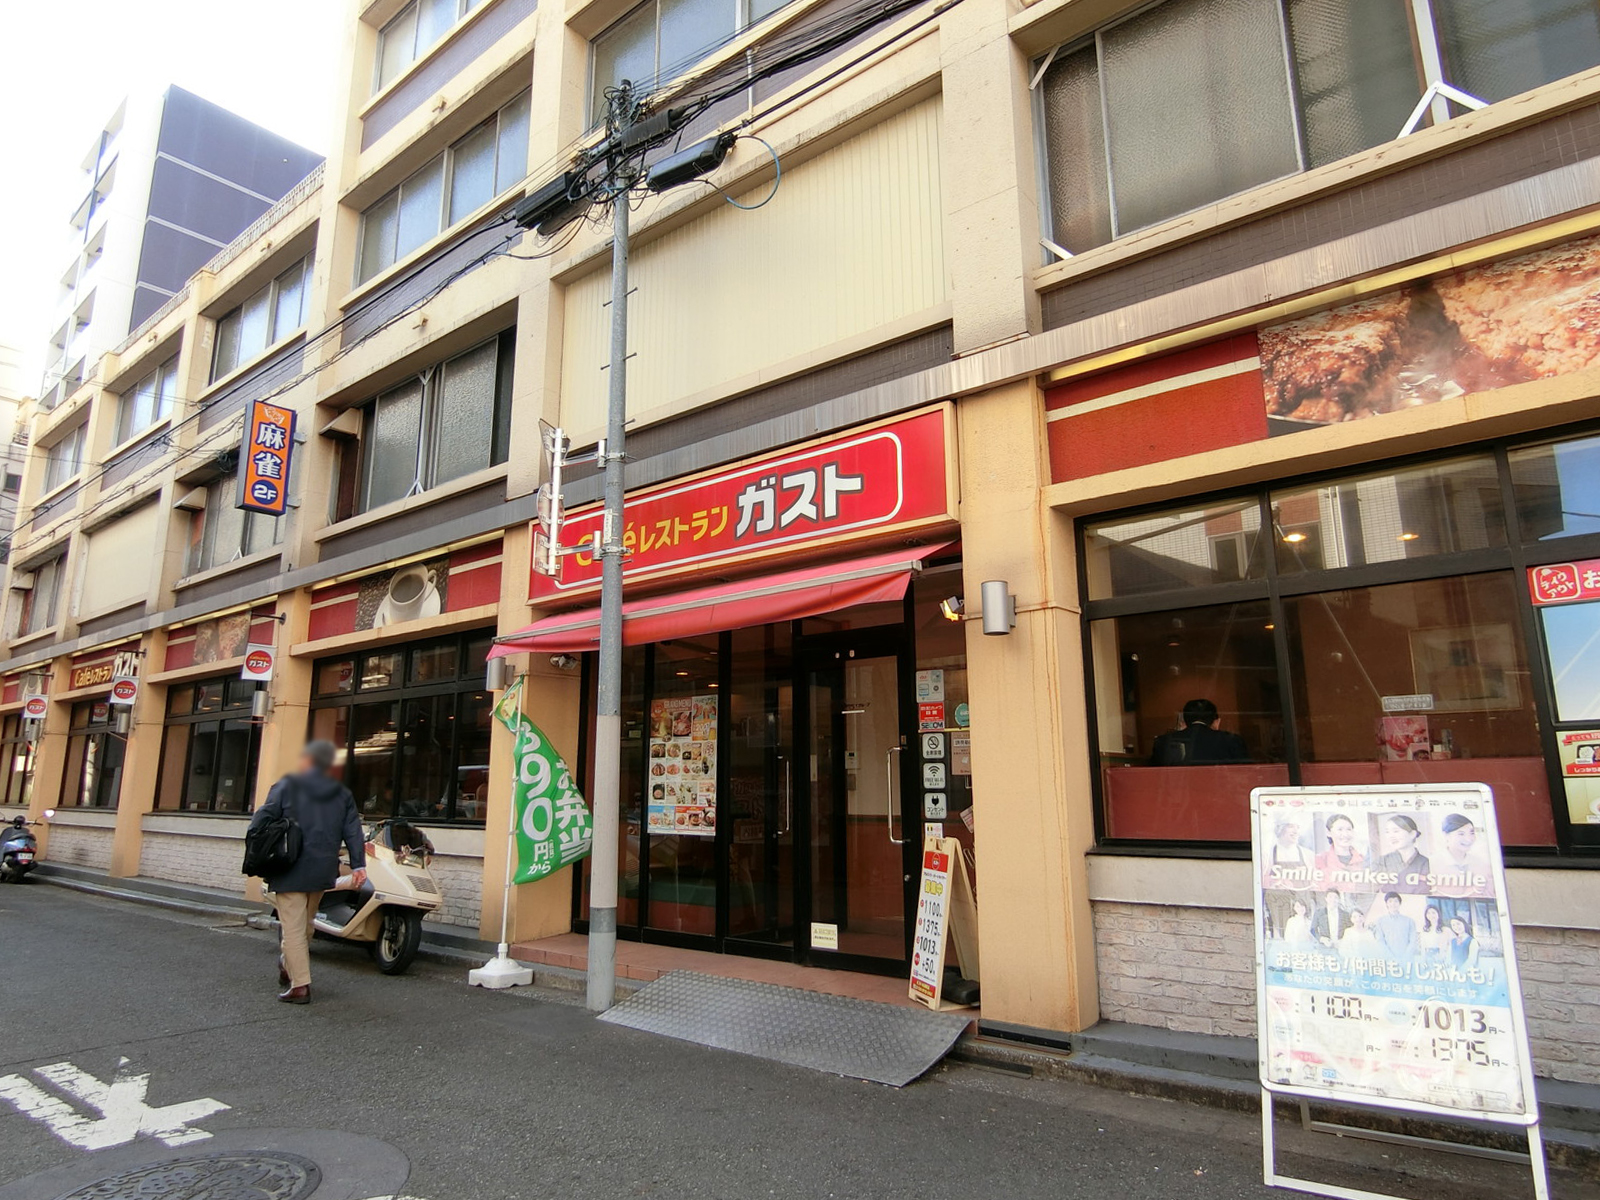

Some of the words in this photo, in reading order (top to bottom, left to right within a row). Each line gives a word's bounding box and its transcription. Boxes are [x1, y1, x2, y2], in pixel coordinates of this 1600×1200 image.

[255, 422, 286, 479] 麻雀
[253, 484, 277, 500] 2F
[575, 505, 729, 566] Céレストラン
[735, 463, 864, 539] ガスト
[1547, 580, 1575, 598] アウト
[112, 652, 140, 680] ガスト
[248, 659, 270, 668] ガスト
[1271, 864, 1324, 881] Smile
[1330, 867, 1399, 885] makes
[1405, 872, 1420, 886] a
[1426, 870, 1487, 887] smile
